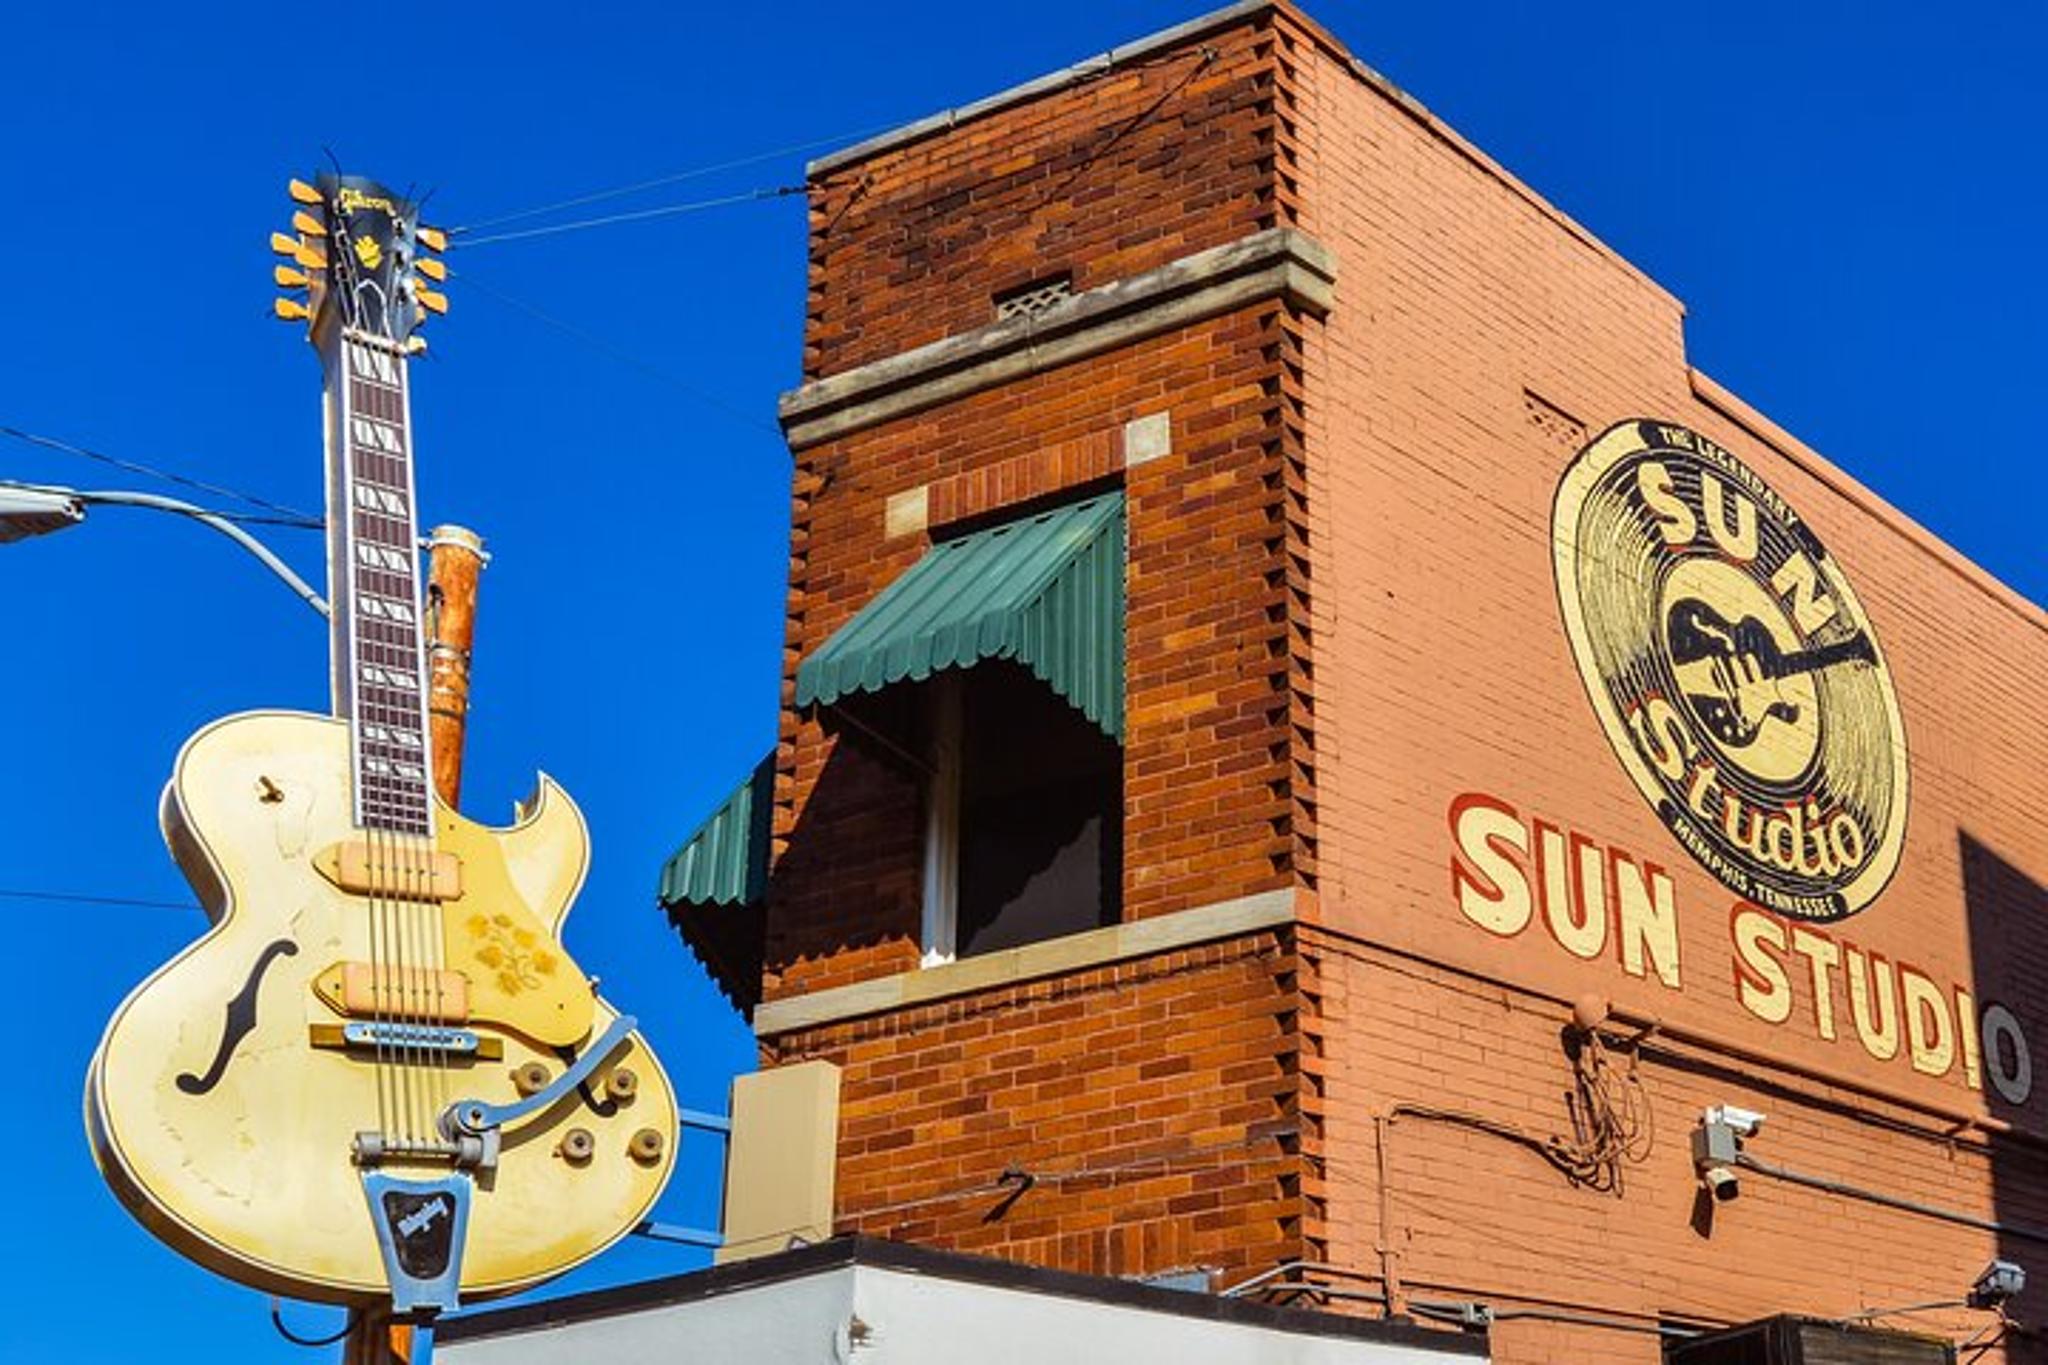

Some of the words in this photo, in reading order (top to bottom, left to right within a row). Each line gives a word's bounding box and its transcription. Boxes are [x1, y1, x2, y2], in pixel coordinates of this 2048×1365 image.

[1637, 460, 1837, 637] SUN
[1657, 426, 1694, 450] THE
[1697, 436, 1799, 528] LEGENDARY
[1627, 690, 1864, 877] Studio
[1449, 793, 1683, 989] SUN
[1731, 891, 2033, 1104] STUDIO
[1753, 883, 1838, 917] TENNESSEE
